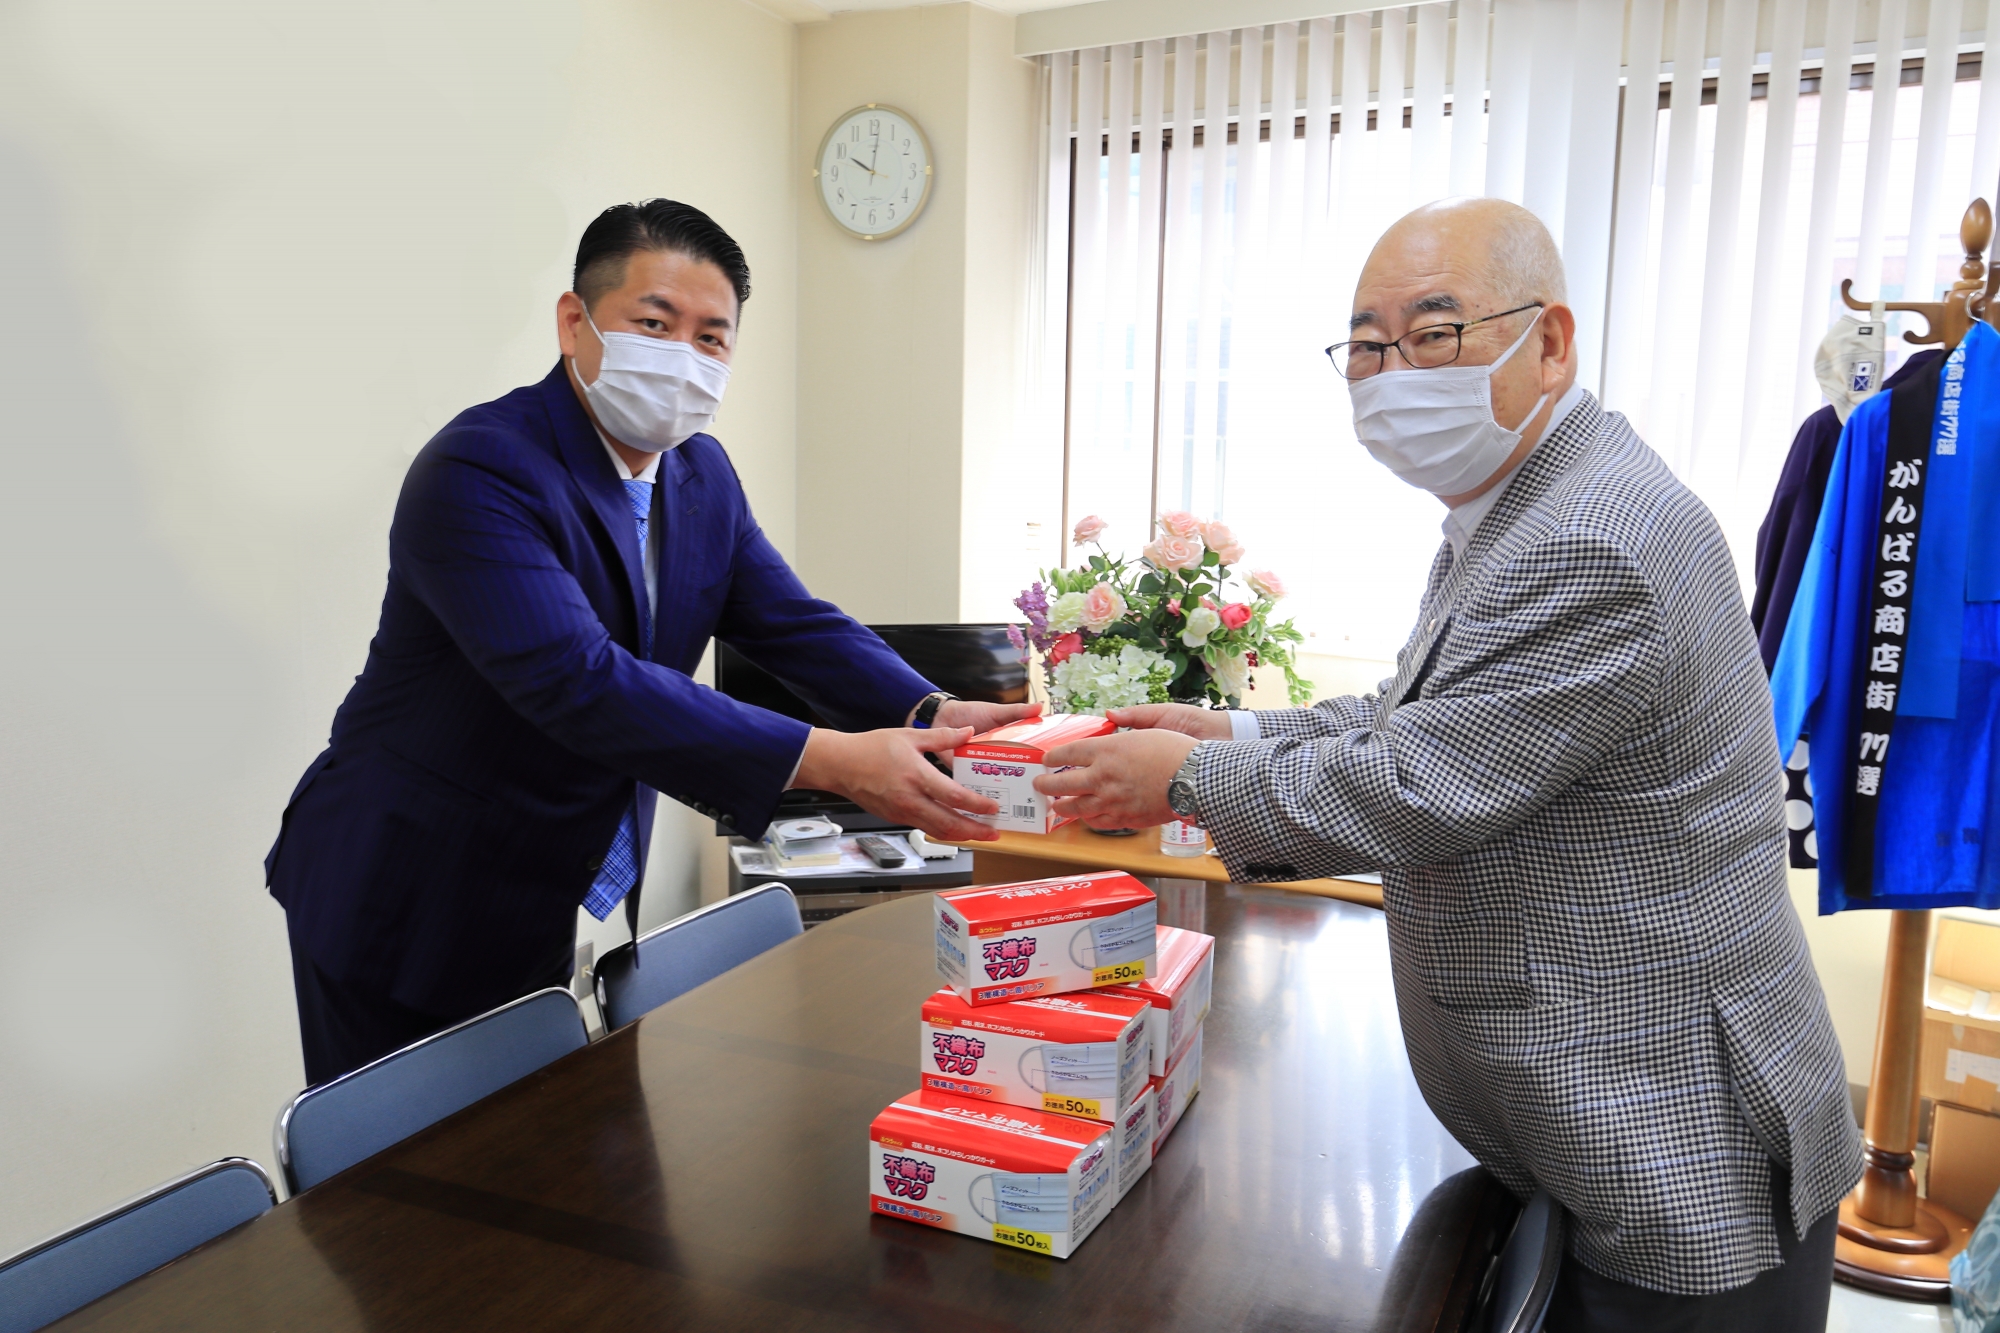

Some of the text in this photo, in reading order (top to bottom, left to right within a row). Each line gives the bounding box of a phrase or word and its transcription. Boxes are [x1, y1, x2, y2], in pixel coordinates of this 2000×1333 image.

[851, 125, 860, 142] 11
[869, 118, 880, 137] 12
[890, 124, 895, 141] 1
[836, 142, 847, 159] 10
[902, 138, 911, 155] 2
[831, 165, 838, 182] 9
[908, 162, 917, 180] 3
[837, 187, 845, 205] 8
[901, 187, 909, 203] 4
[850, 203, 858, 220] 7
[868, 208, 876, 226] 6
[888, 203, 896, 220] 5
[983, 937, 1037, 960] 不織布
[984, 958, 1030, 981] マスク
[933, 1032, 986, 1059] 不織布
[933, 1053, 978, 1075] マスク
[883, 1153, 935, 1184] 不織布
[884, 1175, 928, 1201] マスク
